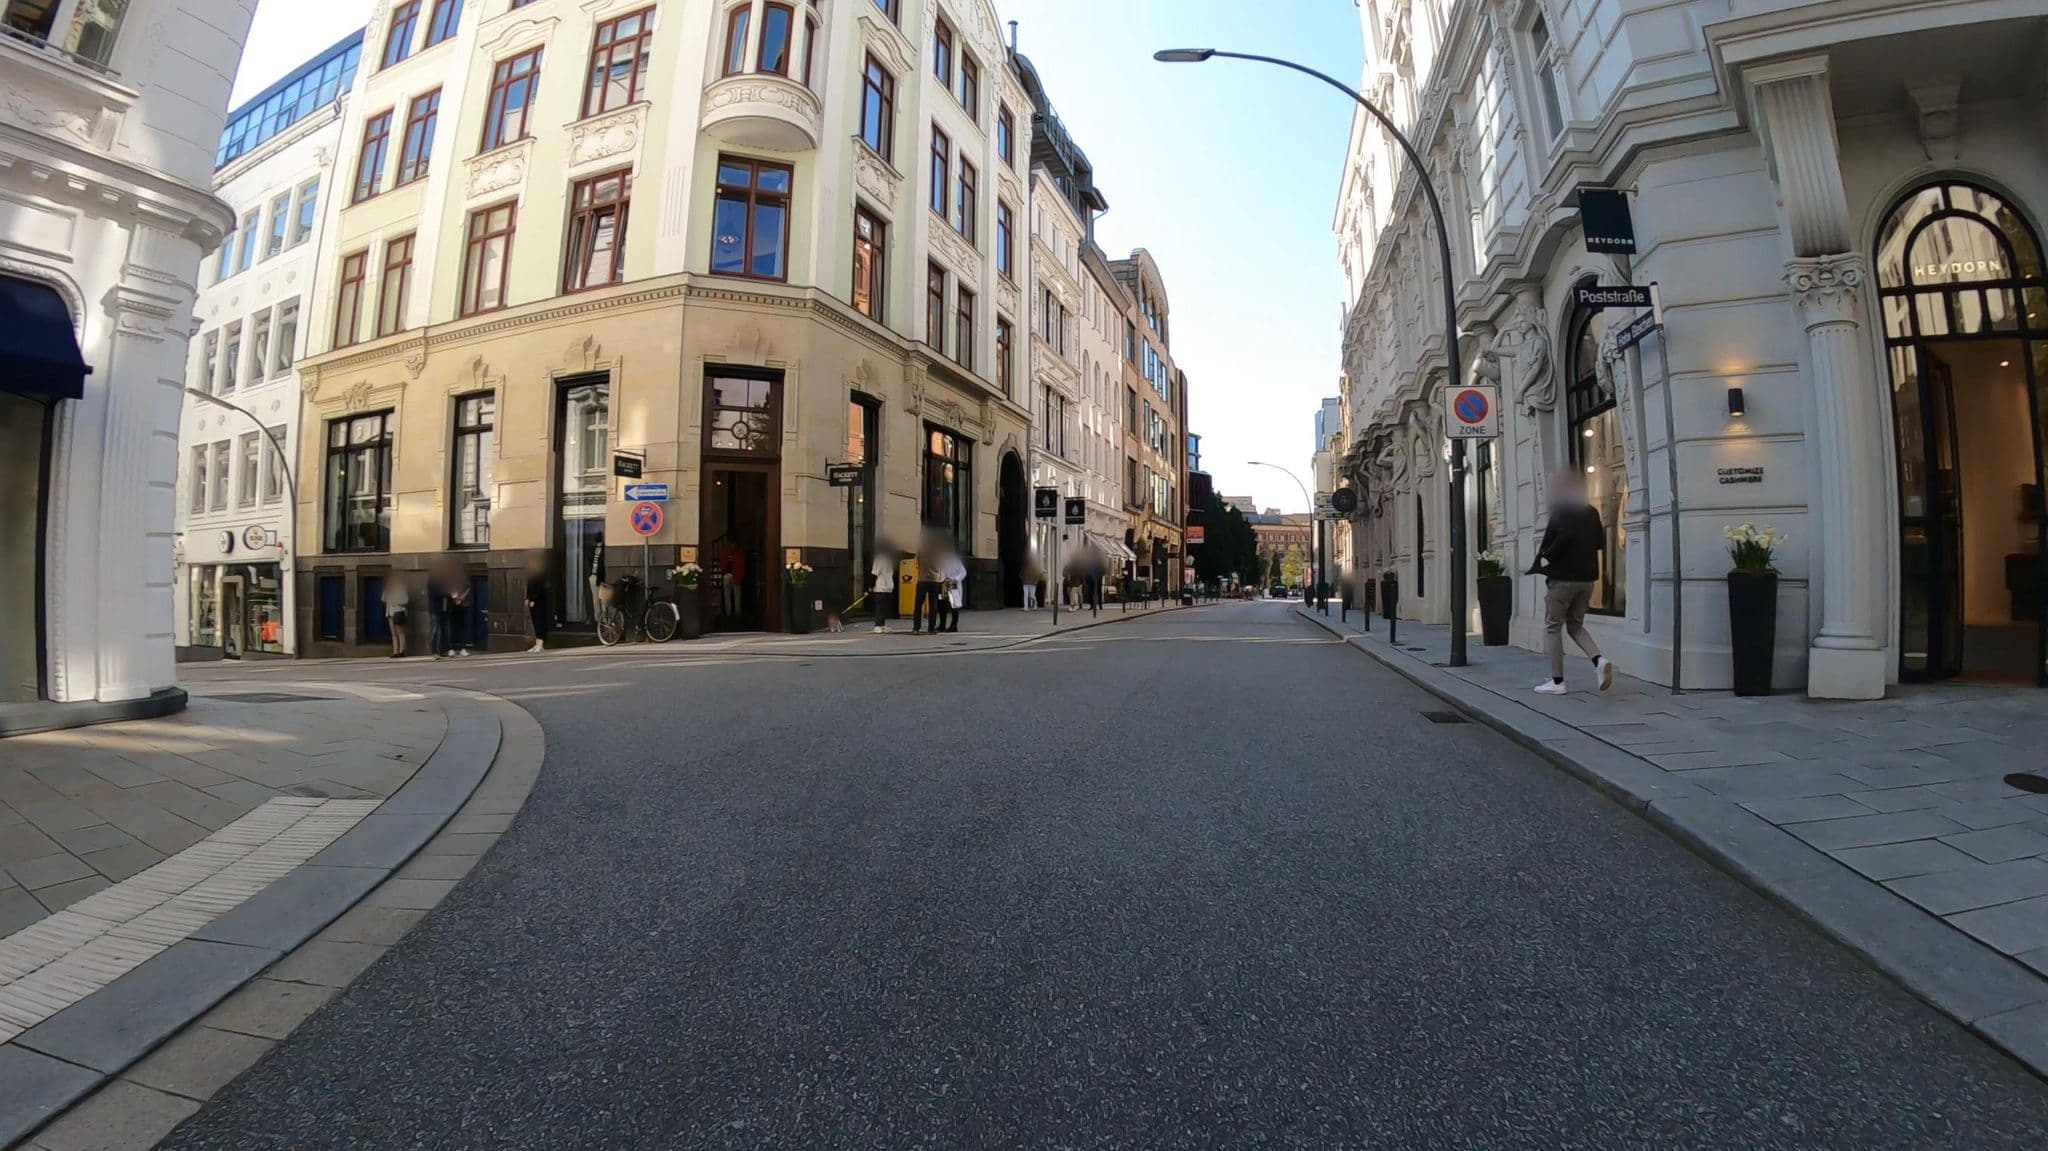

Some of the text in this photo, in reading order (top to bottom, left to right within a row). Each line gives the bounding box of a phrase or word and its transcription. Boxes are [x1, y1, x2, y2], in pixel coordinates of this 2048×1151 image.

[1587, 237, 1634, 245] HEYDORN
[1914, 260, 2001, 277] HEYDORN
[1579, 289, 1645, 303] Poststraße
[1459, 425, 1486, 435] ZONE
